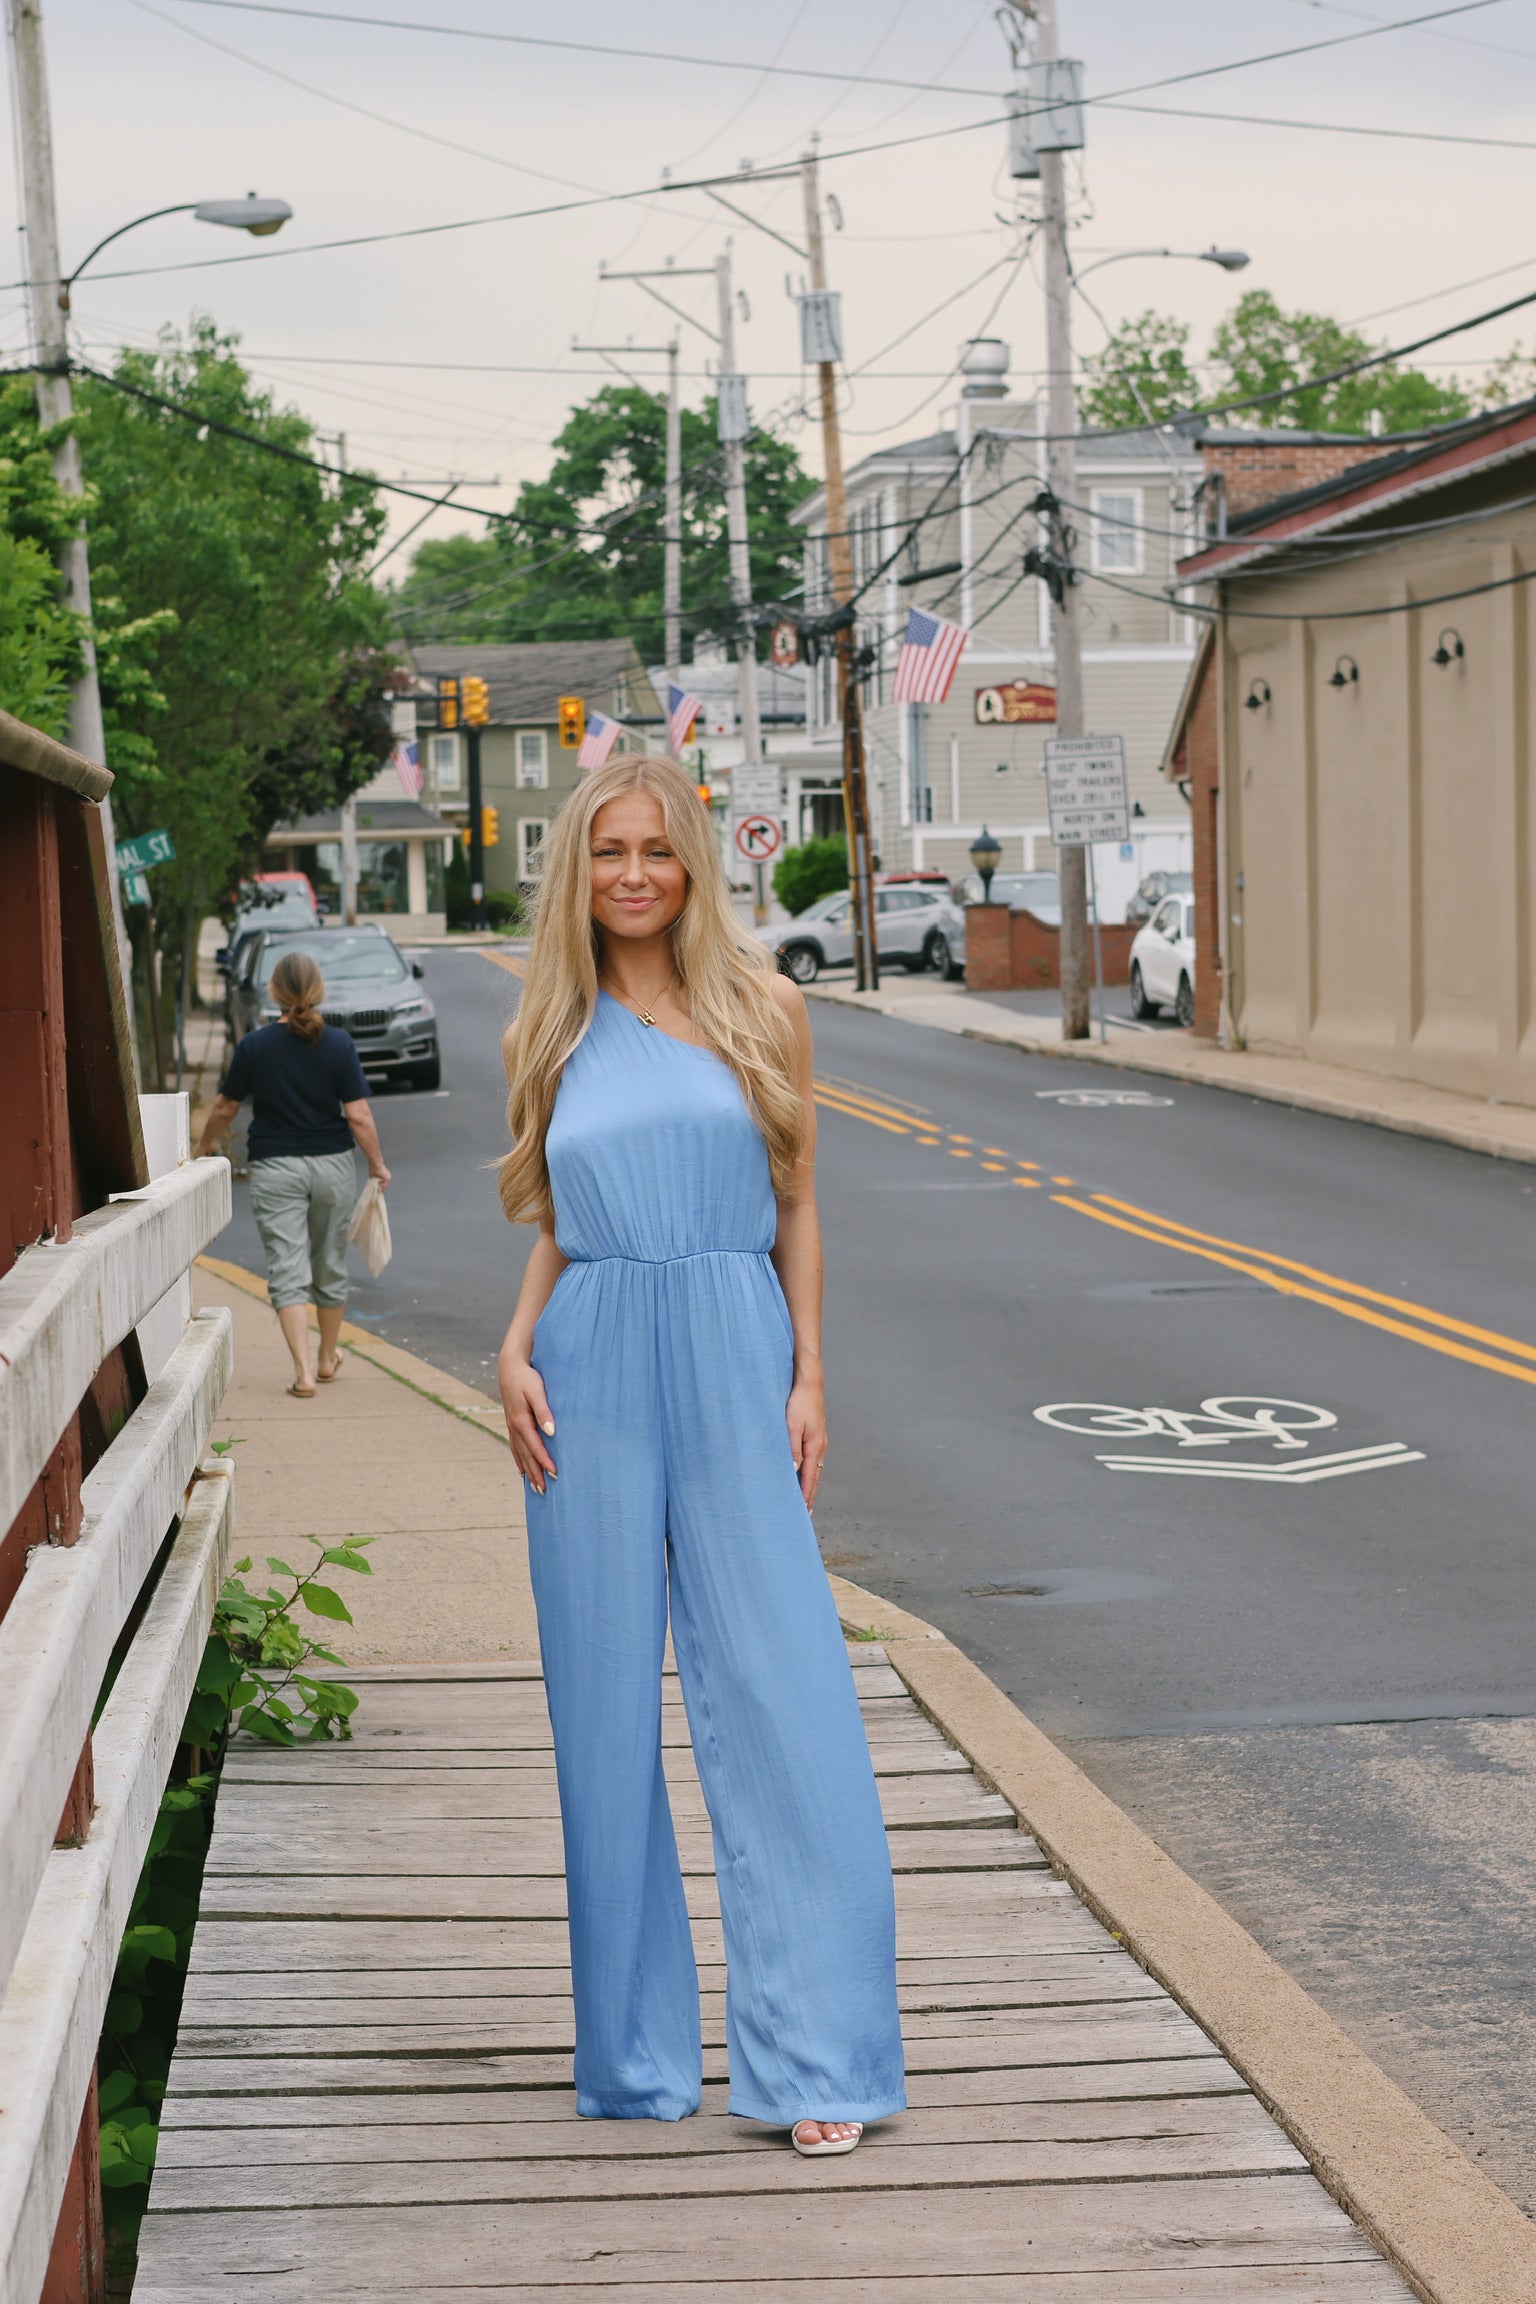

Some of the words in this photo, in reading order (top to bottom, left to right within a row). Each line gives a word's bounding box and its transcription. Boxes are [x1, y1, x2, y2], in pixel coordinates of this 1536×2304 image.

[1055, 740, 1113, 751] PROHIBITED
[1085, 761, 1113, 771] TWINS
[1077, 776, 1121, 787] TRAILERS
[1051, 794, 1076, 805] OVER
[1063, 815, 1095, 824] NORTH
[1102, 813, 1115, 822] ON
[1058, 831, 1081, 841] MAIN
[1089, 828, 1123, 839] STREET
[147, 833, 172, 860] ST
